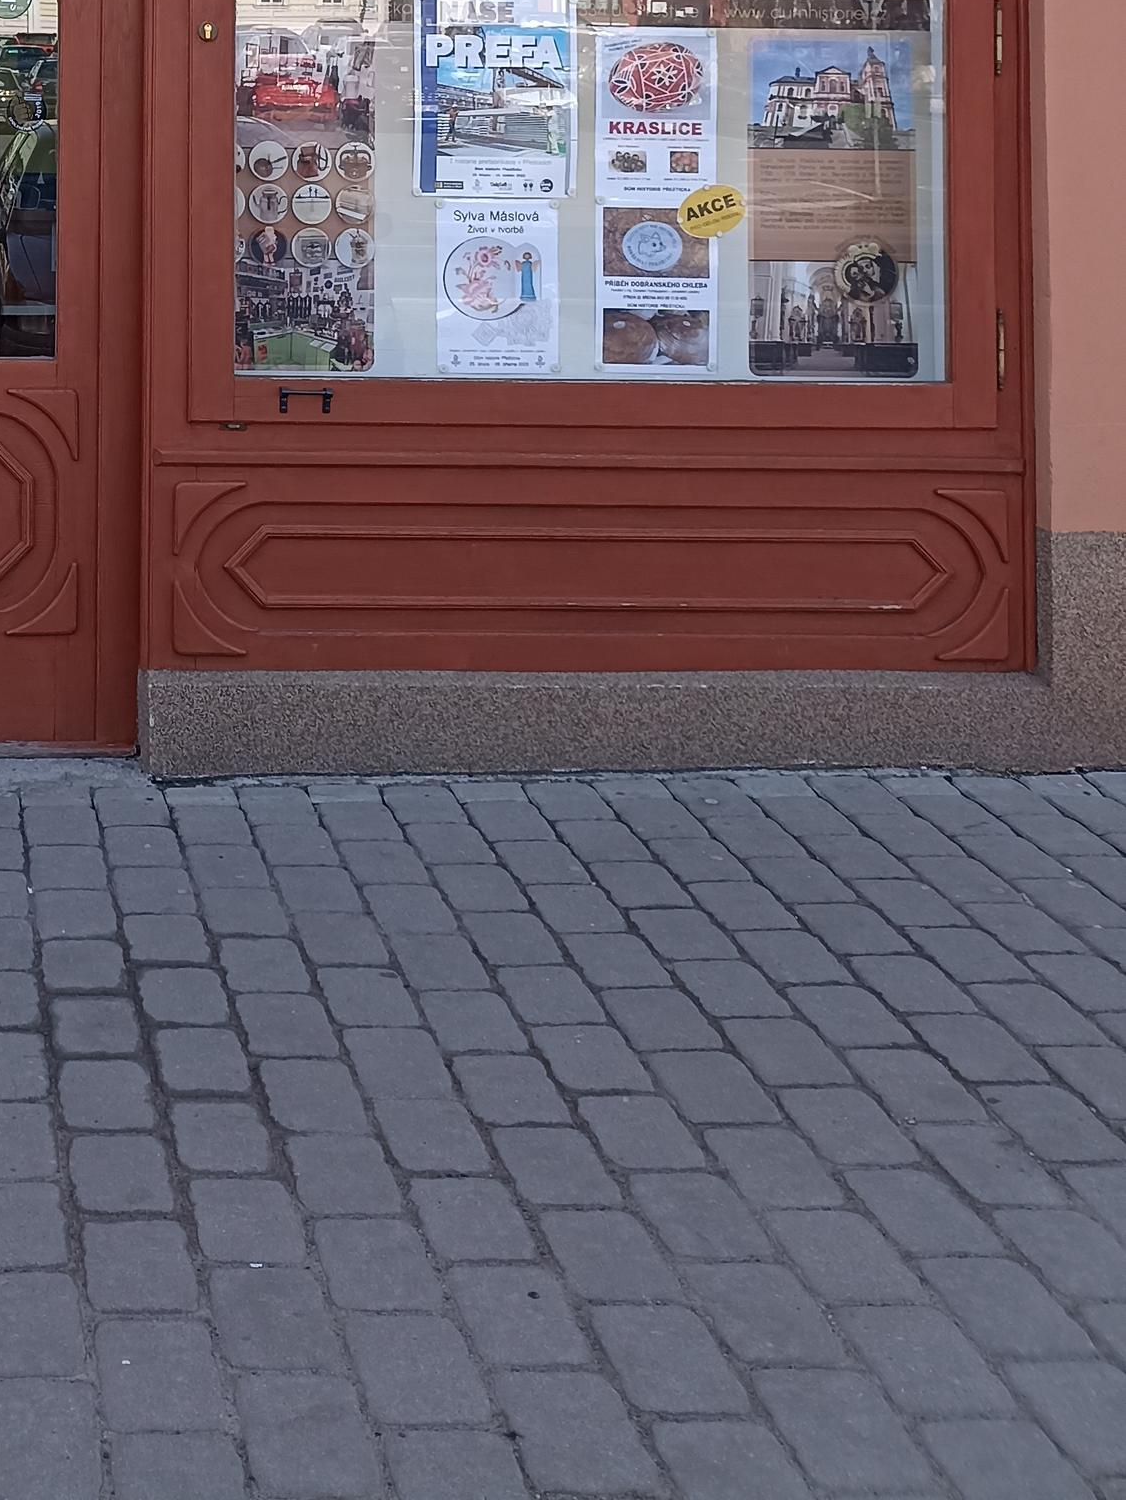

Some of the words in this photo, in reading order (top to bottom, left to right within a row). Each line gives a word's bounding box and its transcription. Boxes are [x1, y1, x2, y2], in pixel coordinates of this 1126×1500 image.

[425, 33, 566, 71] PREFA
[608, 120, 703, 136] KRASLICE
[686, 193, 737, 222] AKCE
[453, 210, 485, 223] Sylva
[489, 209, 539, 222] Máslová
[467, 225, 489, 234] Život
[497, 226, 524, 234] tvorbě
